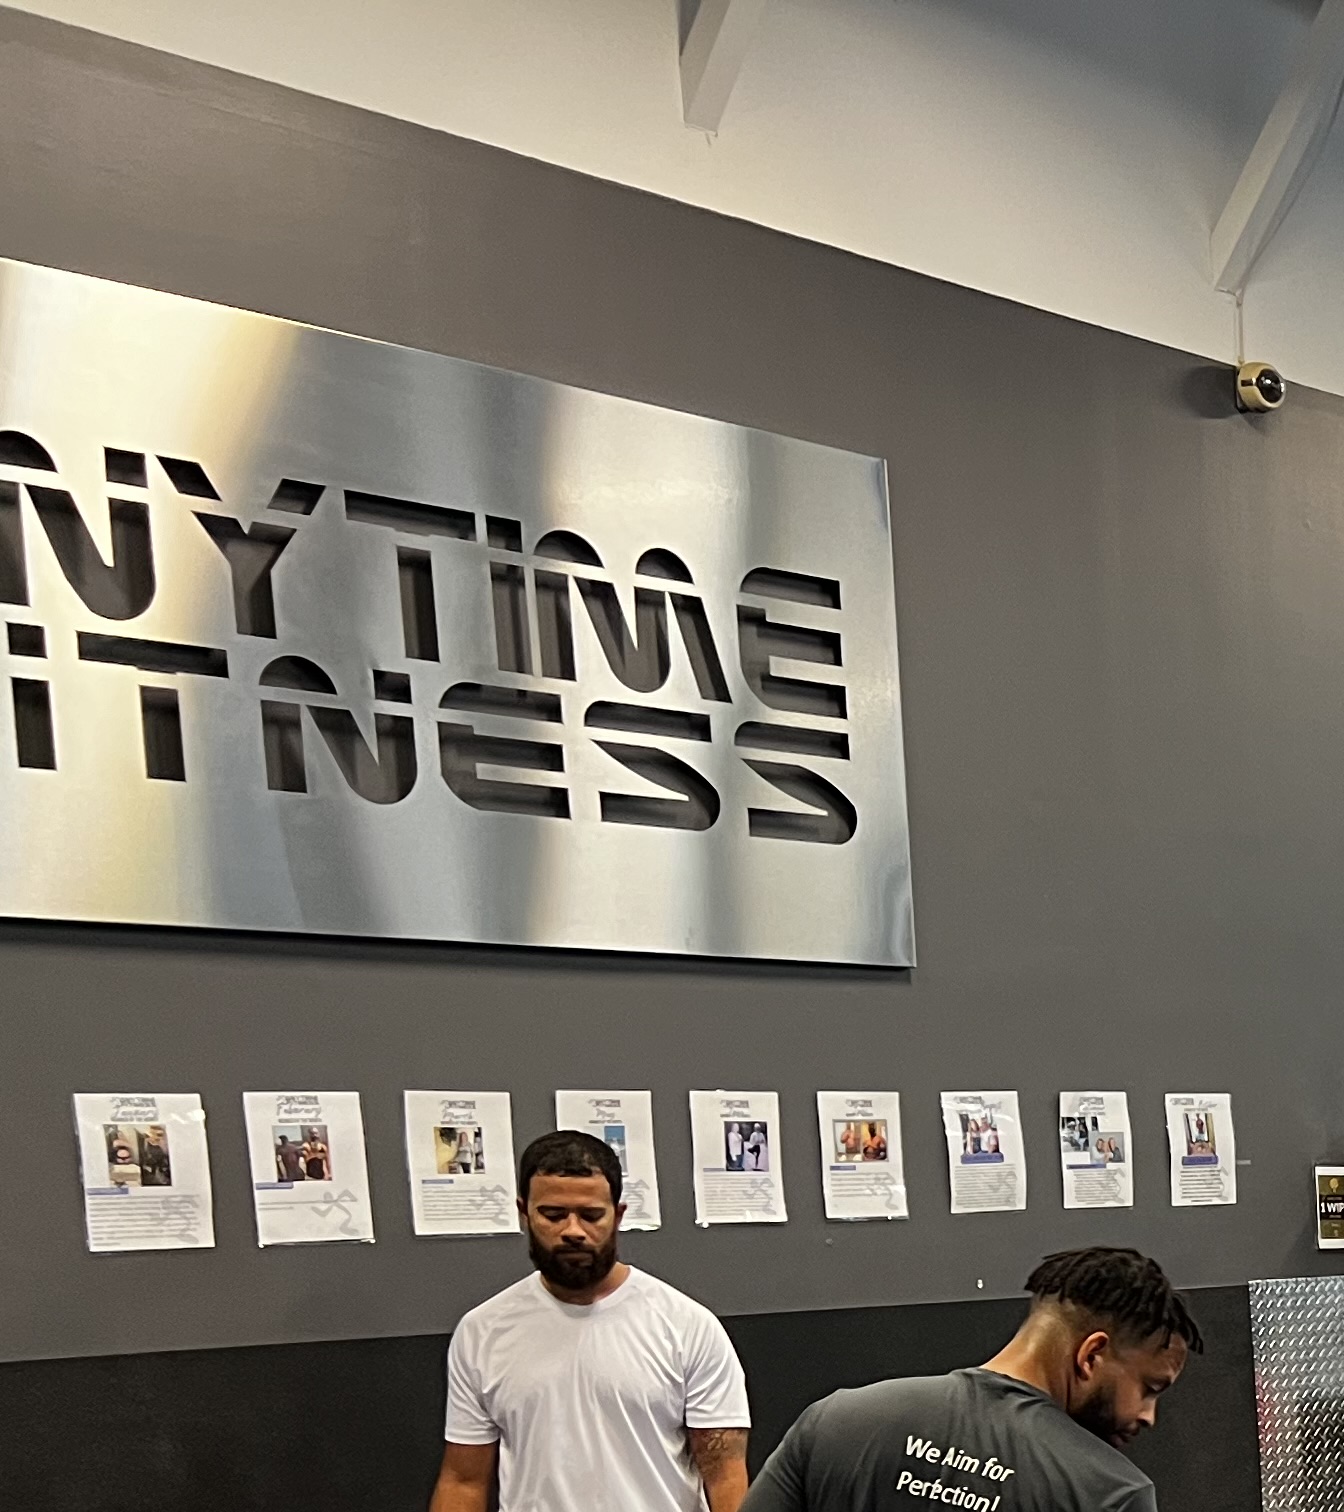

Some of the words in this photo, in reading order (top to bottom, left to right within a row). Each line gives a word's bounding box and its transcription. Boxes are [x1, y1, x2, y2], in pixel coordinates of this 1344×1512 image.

[1320, 1202, 1327, 1214] 1
[904, 1435, 941, 1465] We
[942, 1446, 981, 1475] Aim
[983, 1456, 1015, 1484] for
